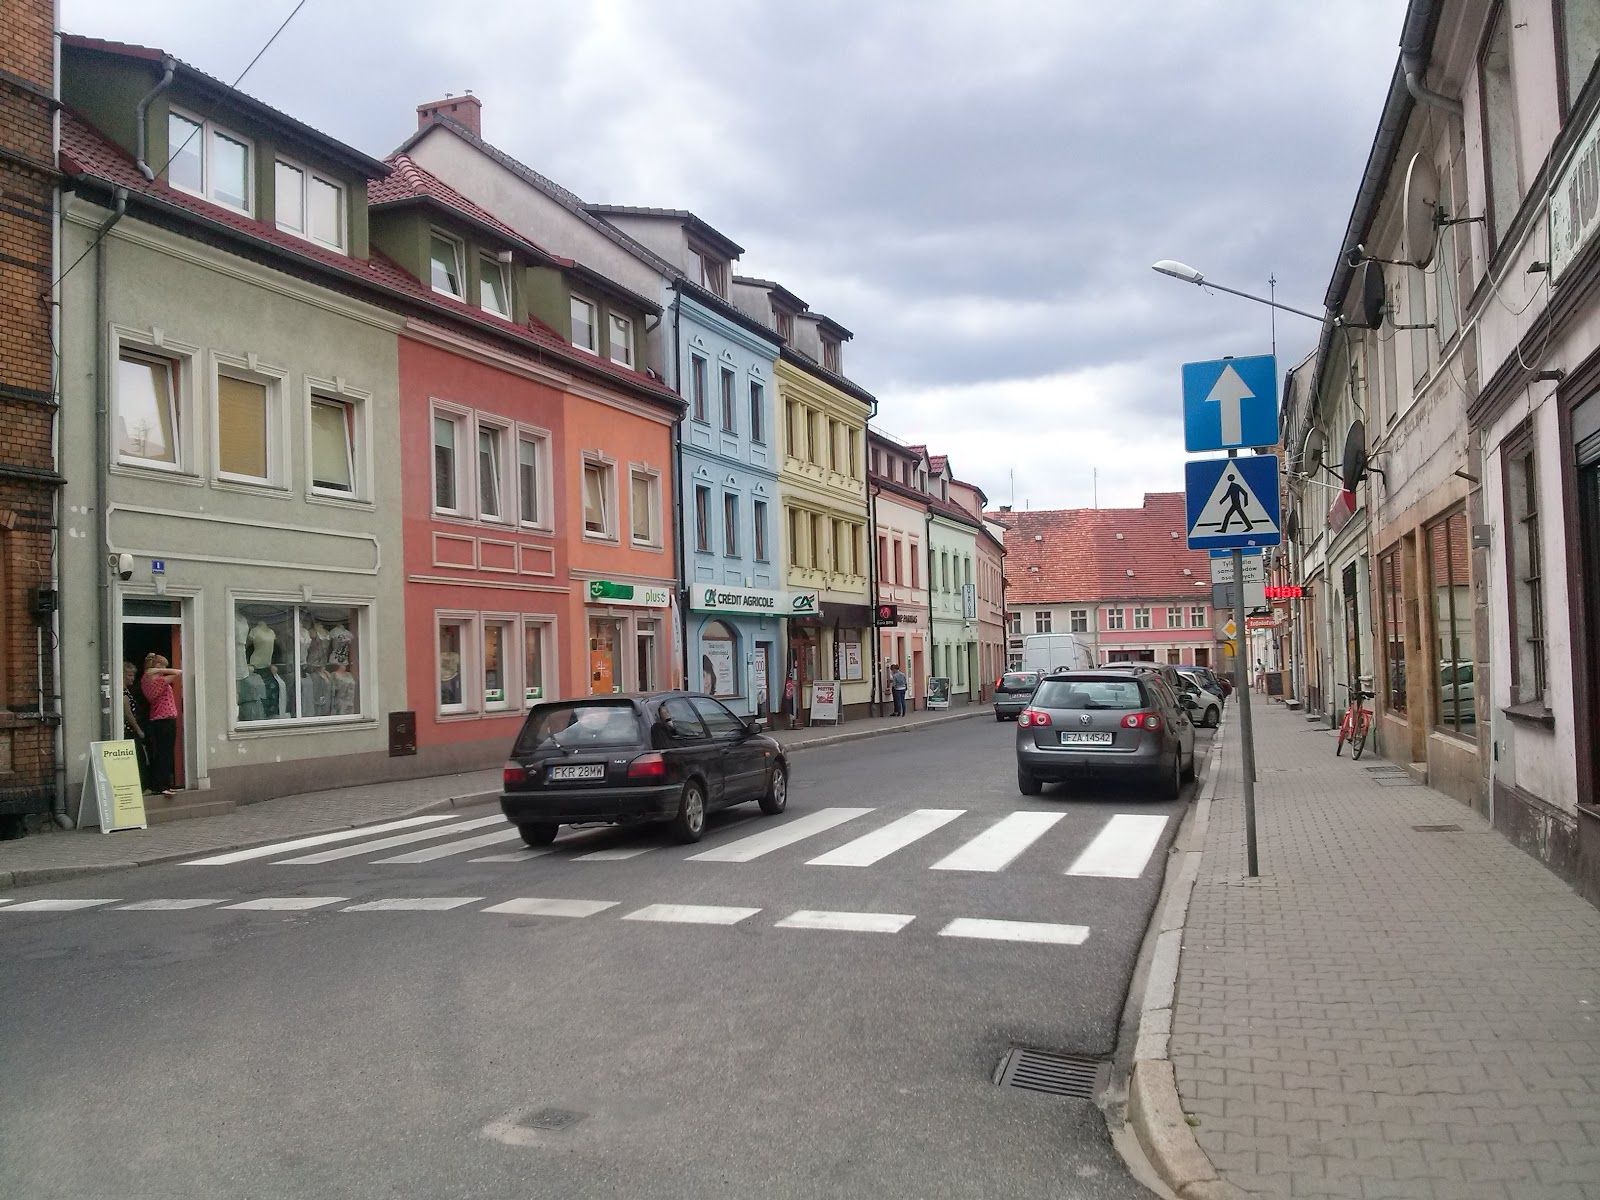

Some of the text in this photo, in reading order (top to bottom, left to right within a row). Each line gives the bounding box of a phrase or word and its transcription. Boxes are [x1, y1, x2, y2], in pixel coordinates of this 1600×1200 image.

[645, 589, 660, 604] plus
[717, 592, 743, 605] CRÉDIT
[743, 595, 774, 608] AGRICOLE
[1066, 733, 1110, 743] FZA 14542
[103, 748, 135, 758] Pralnia
[554, 765, 604, 779] FKR 28MW
